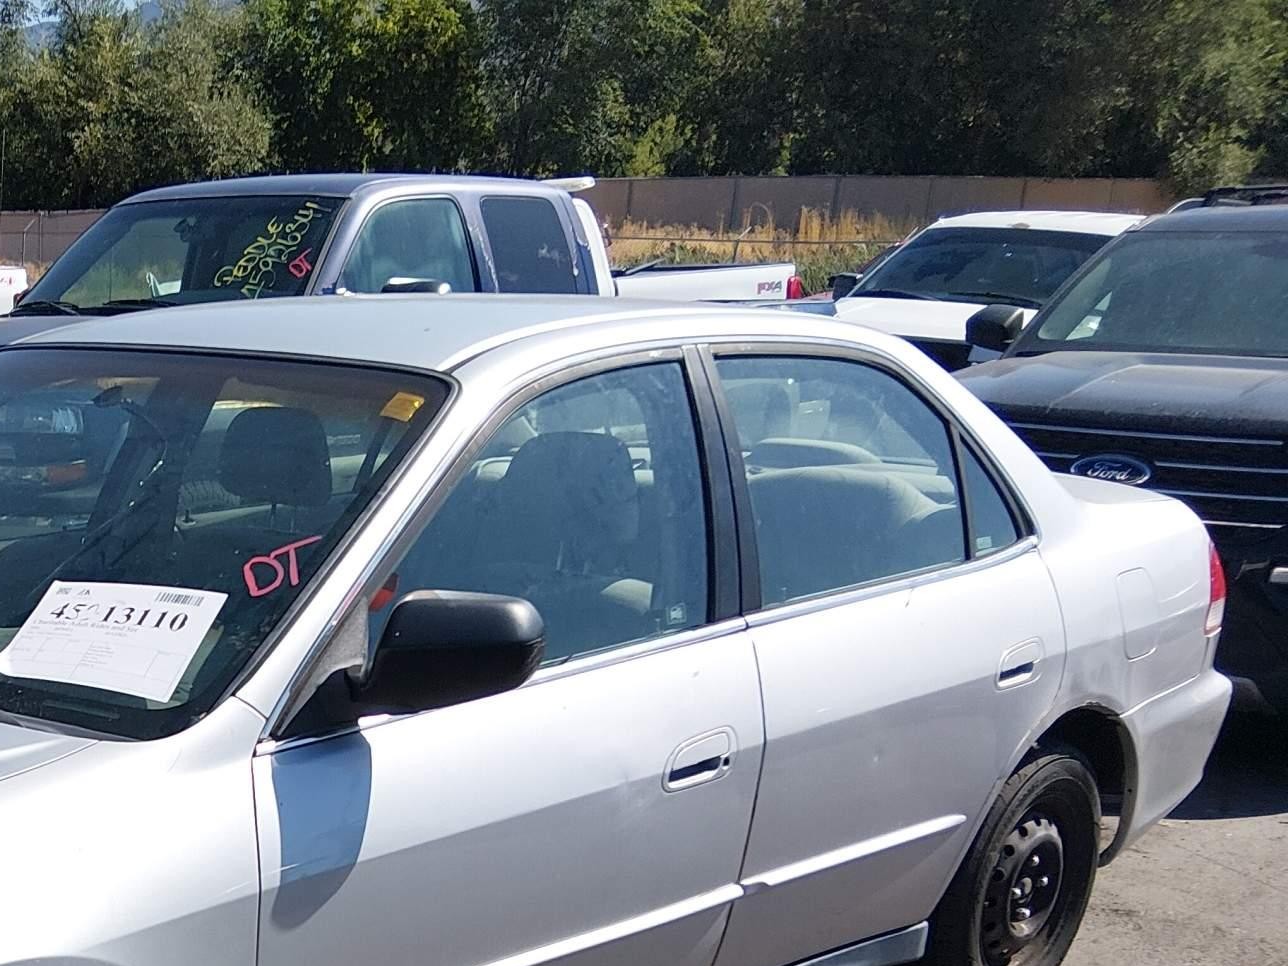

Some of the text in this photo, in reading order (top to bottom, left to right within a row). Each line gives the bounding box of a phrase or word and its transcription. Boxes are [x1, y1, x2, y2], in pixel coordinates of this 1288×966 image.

[214, 215, 283, 286] PEDDLE
[1086, 461, 1132, 480] Ford
[243, 535, 323, 597] DT
